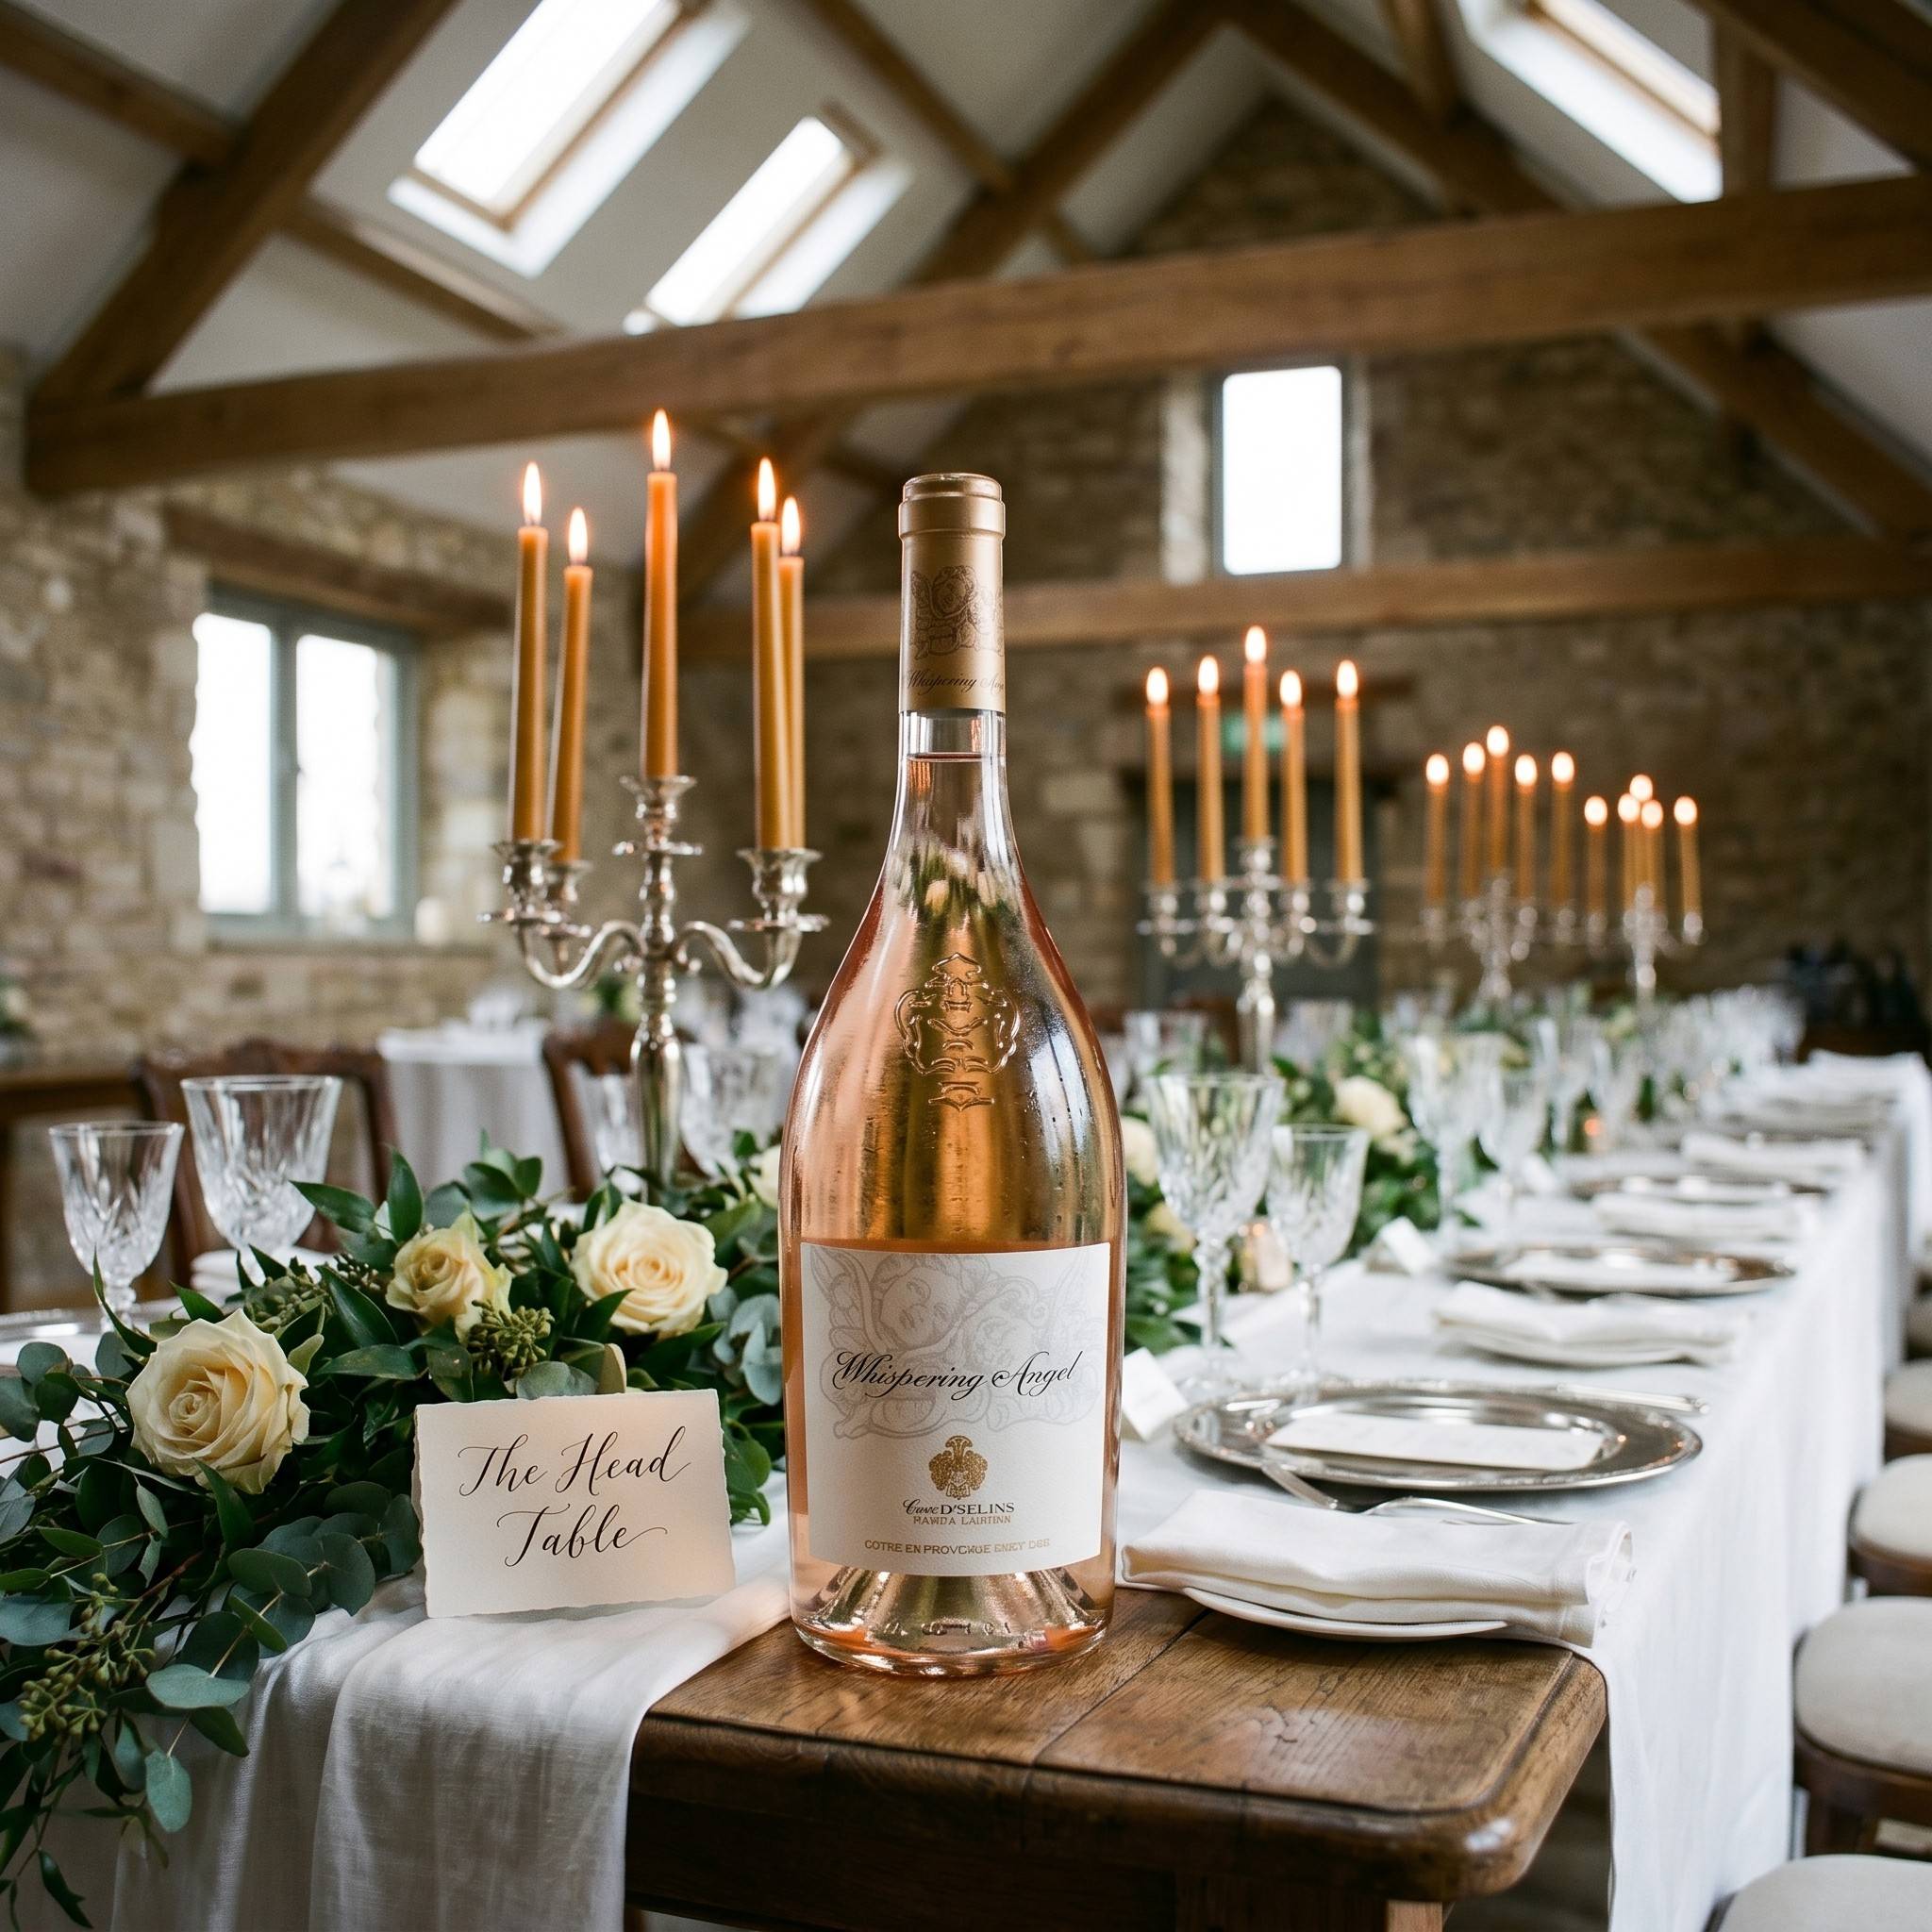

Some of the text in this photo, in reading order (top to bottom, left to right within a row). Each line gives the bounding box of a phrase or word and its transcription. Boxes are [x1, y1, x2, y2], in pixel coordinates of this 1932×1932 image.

[832, 1351, 1083, 1401] Whispering Angel
[458, 1425, 691, 1497] The Head
[496, 1503, 668, 1567] Table
[865, 1540, 903, 1553] COTRE
[906, 1543, 921, 1554] EN
